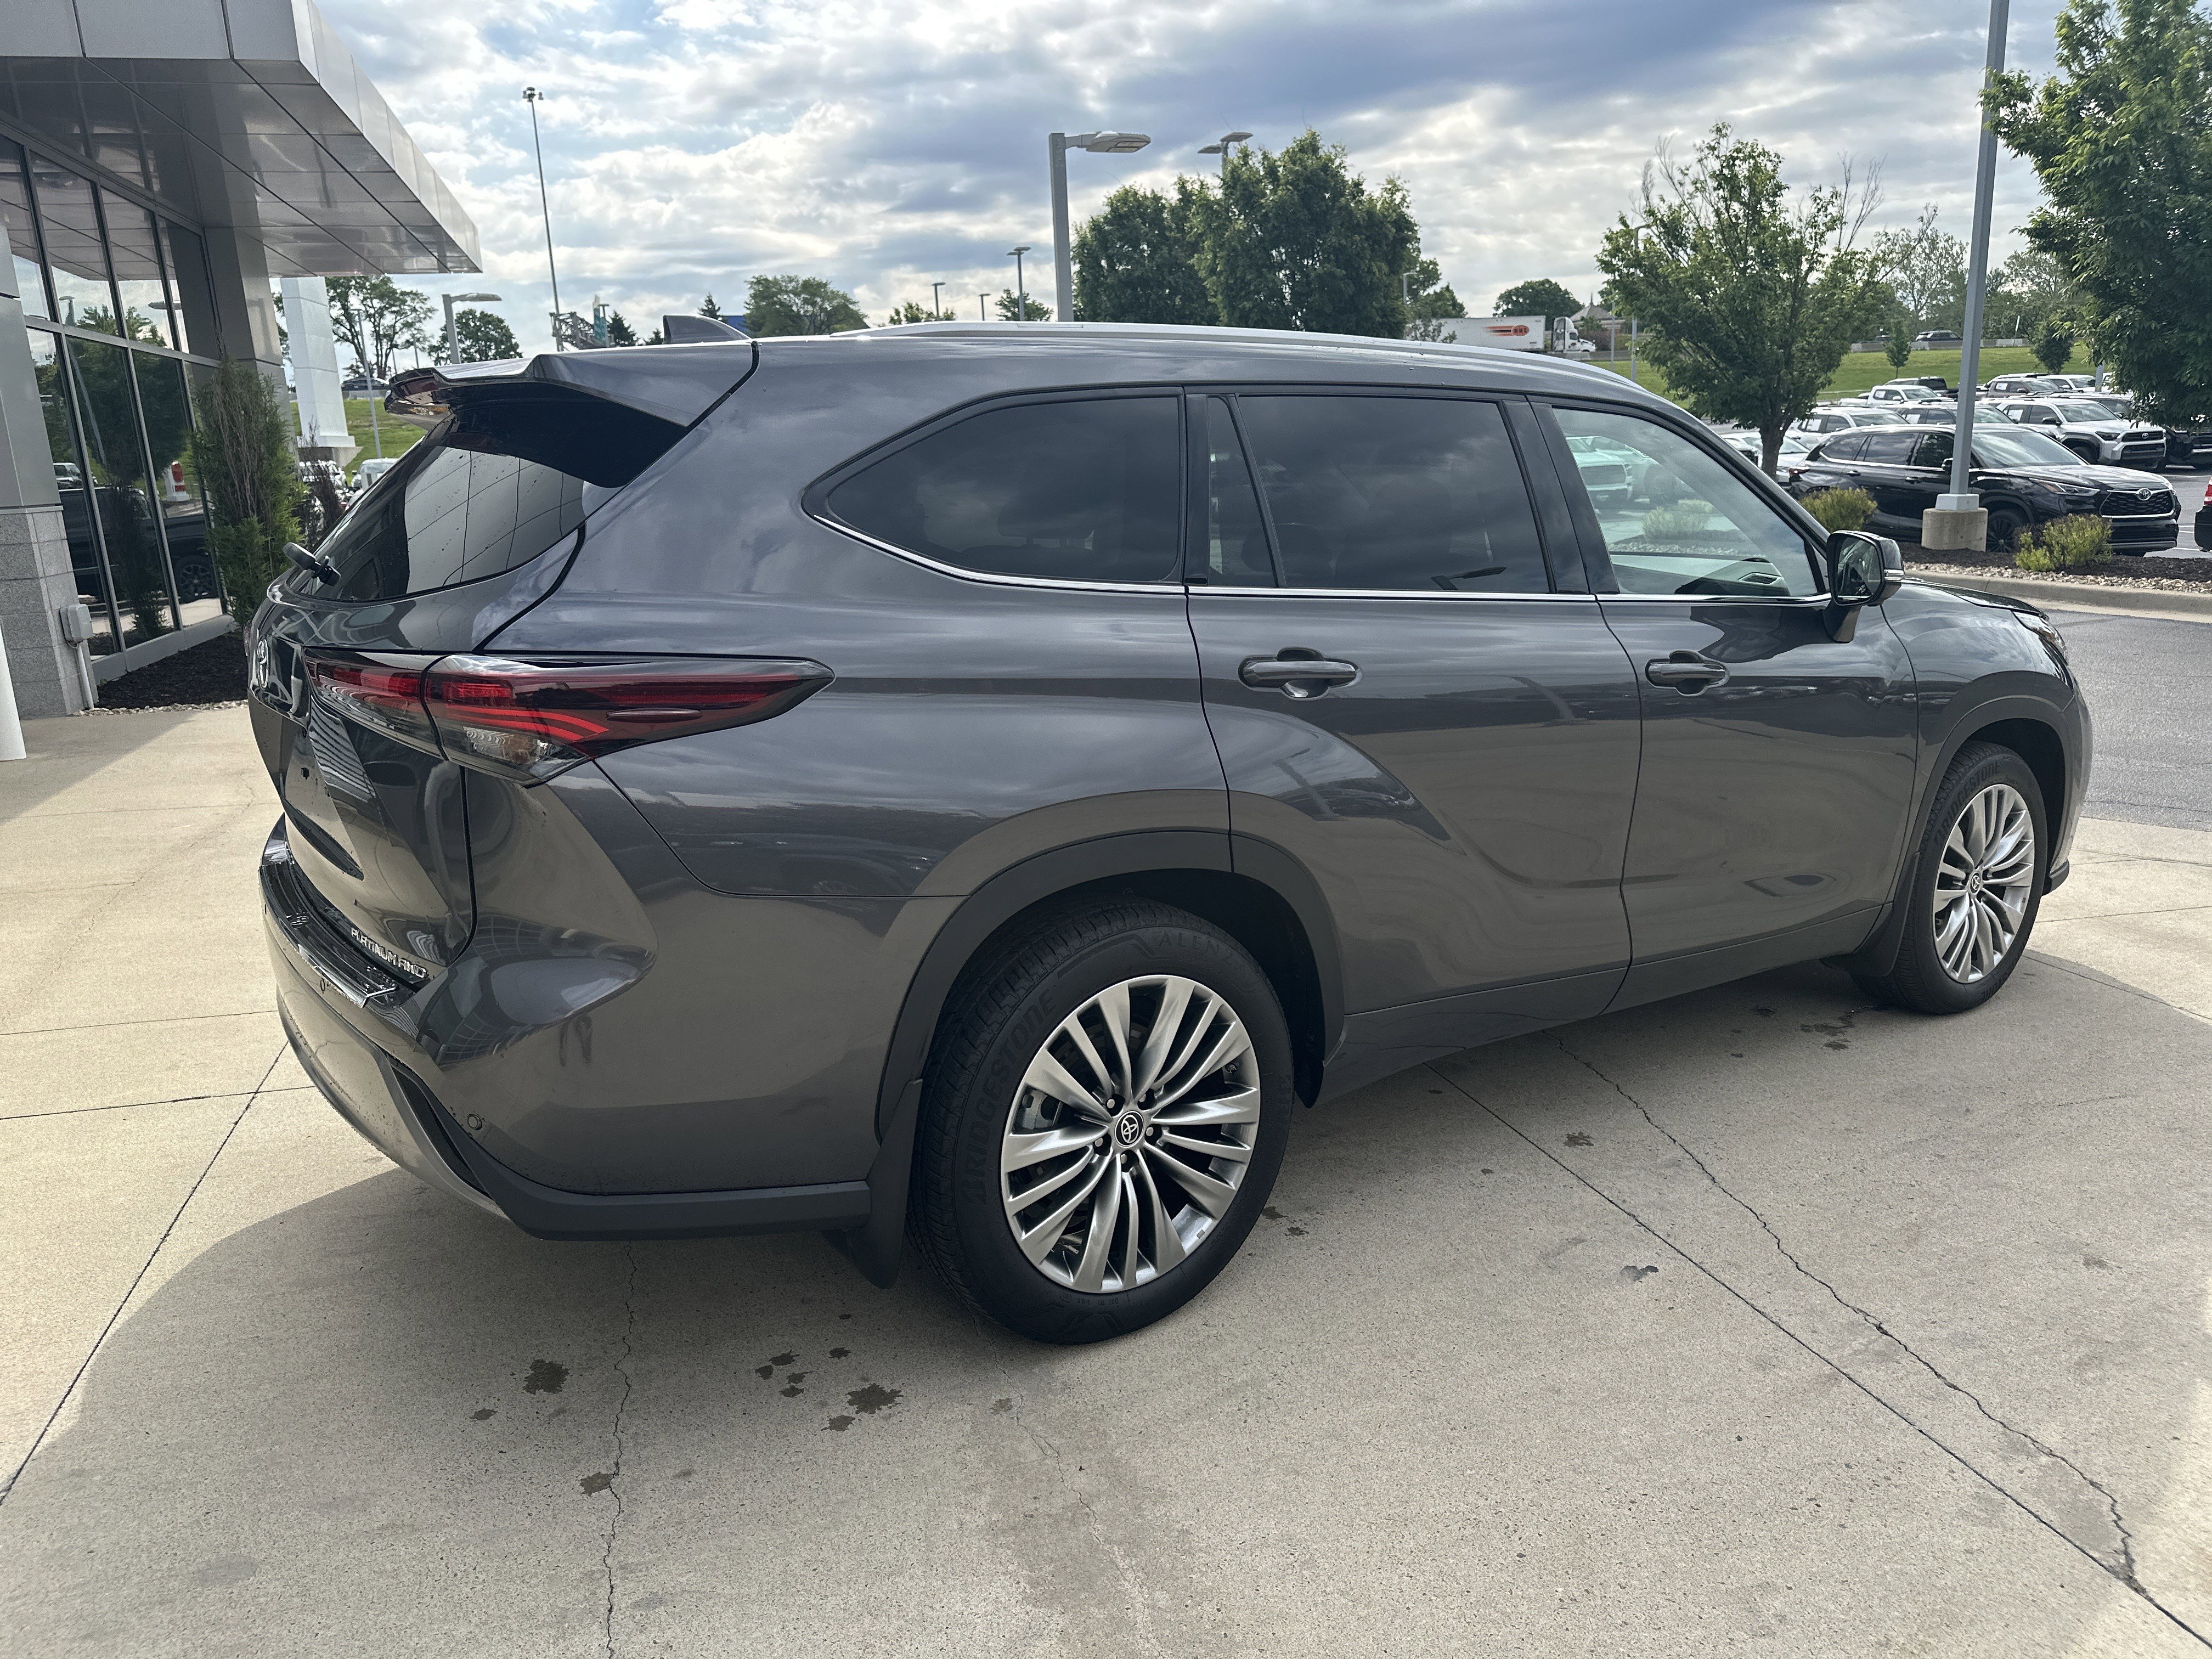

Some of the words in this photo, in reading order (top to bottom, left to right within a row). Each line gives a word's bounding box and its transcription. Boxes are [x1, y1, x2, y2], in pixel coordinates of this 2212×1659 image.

[1934, 761, 2000, 847] BRIDGESTONE
[351, 927, 398, 966] PLATINUM
[398, 958, 427, 978] AWD
[962, 988, 1057, 1206] BRIDGESTONE
